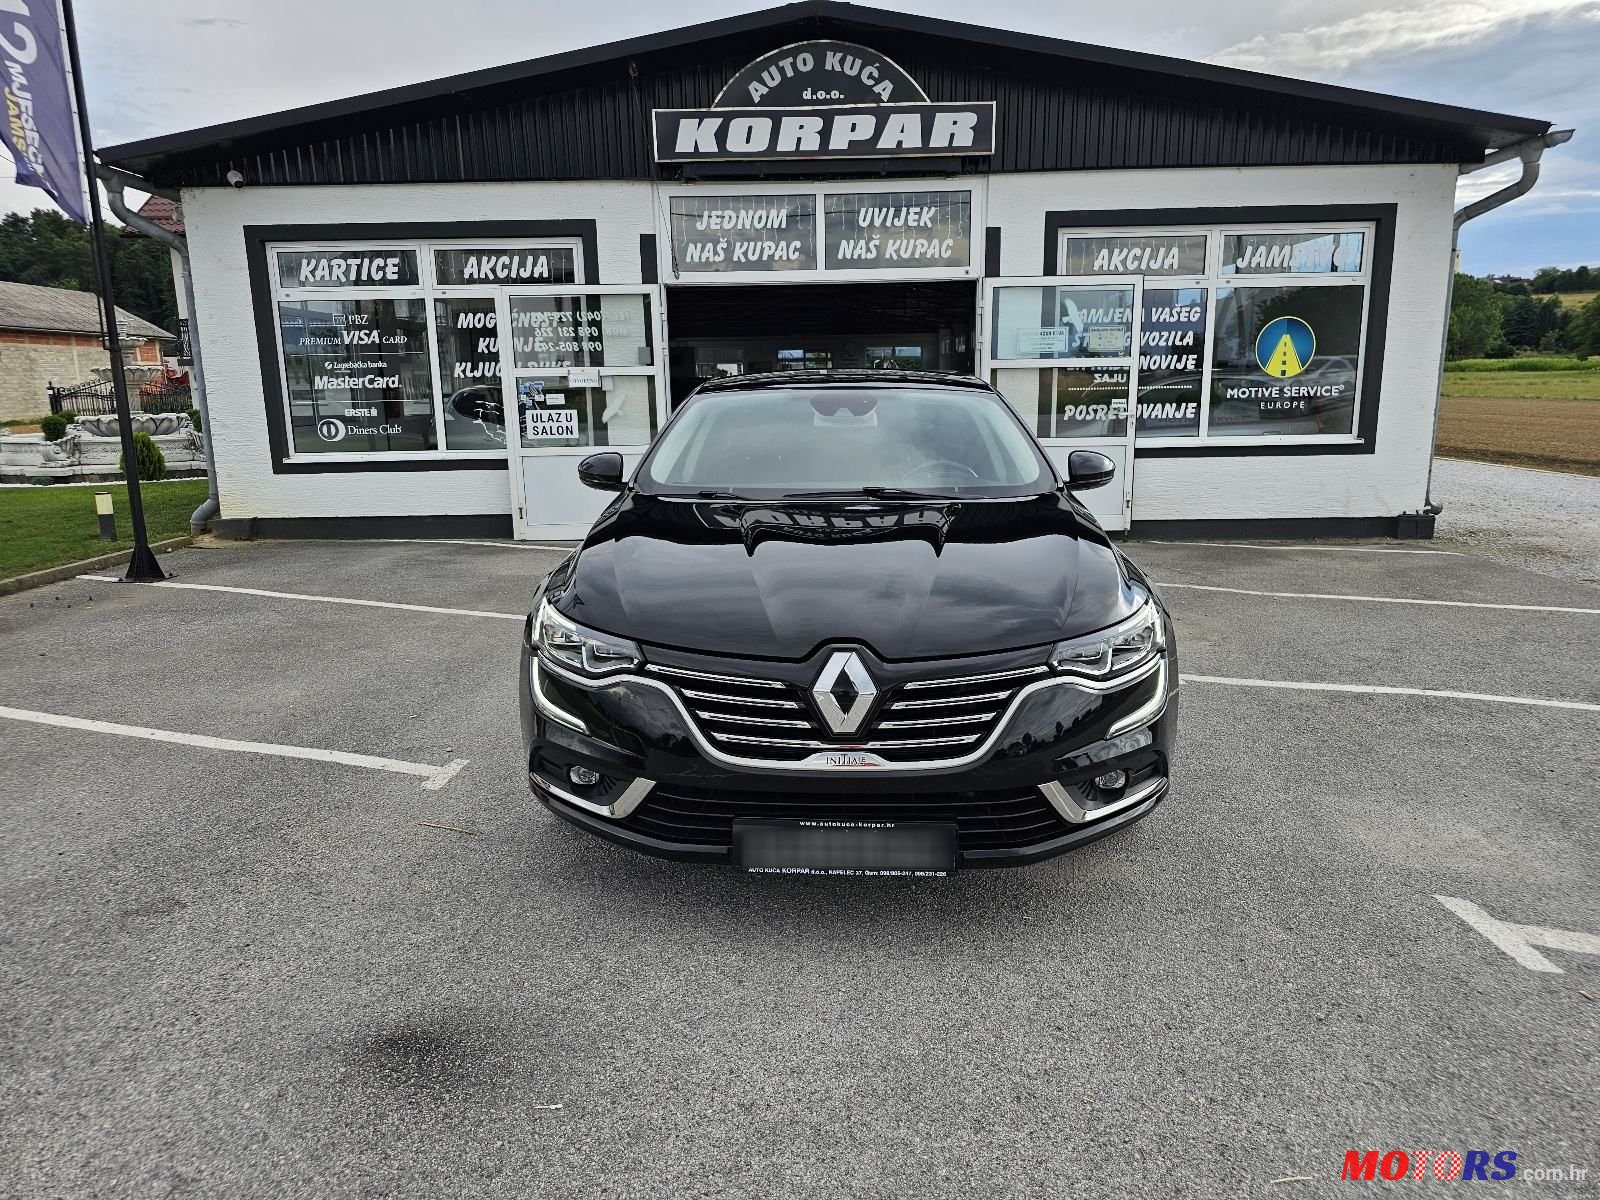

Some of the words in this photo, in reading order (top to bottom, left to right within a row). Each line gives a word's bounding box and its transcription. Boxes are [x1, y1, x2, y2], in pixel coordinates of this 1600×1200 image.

[747, 52, 814, 103] AUTO
[825, 51, 895, 102] KUĆA
[802, 87, 845, 100] d.o.o.
[674, 111, 978, 153] KORPAR
[695, 208, 787, 231] JEDNOM
[858, 206, 937, 229] UVIJEK
[686, 237, 728, 263] NAŠ
[732, 240, 802, 263] KUPAC
[837, 234, 880, 260] NAŠ
[885, 237, 954, 261] KUPAC
[463, 254, 550, 281] AKCIJA
[1093, 247, 1180, 272] AKCIJA
[299, 257, 400, 284] KARTICE
[348, 314, 369, 325] PBZ
[1151, 304, 1201, 323] VAŠEG
[299, 337, 342, 346] PREMIUM
[341, 329, 381, 345] VISA
[382, 336, 408, 344] CARD
[1140, 330, 1194, 347] VOZILA
[368, 360, 388, 368] banka
[1139, 354, 1198, 370] NOVIJE
[1226, 386, 1280, 399] MOTIVE
[344, 408, 371, 417] ERSTE
[1260, 401, 1305, 409] EUROPE
[531, 412, 563, 423] ULAZ
[565, 412, 573, 423] U
[347, 425, 378, 435] Diners
[379, 424, 402, 434] Club
[532, 425, 574, 436] SALON
